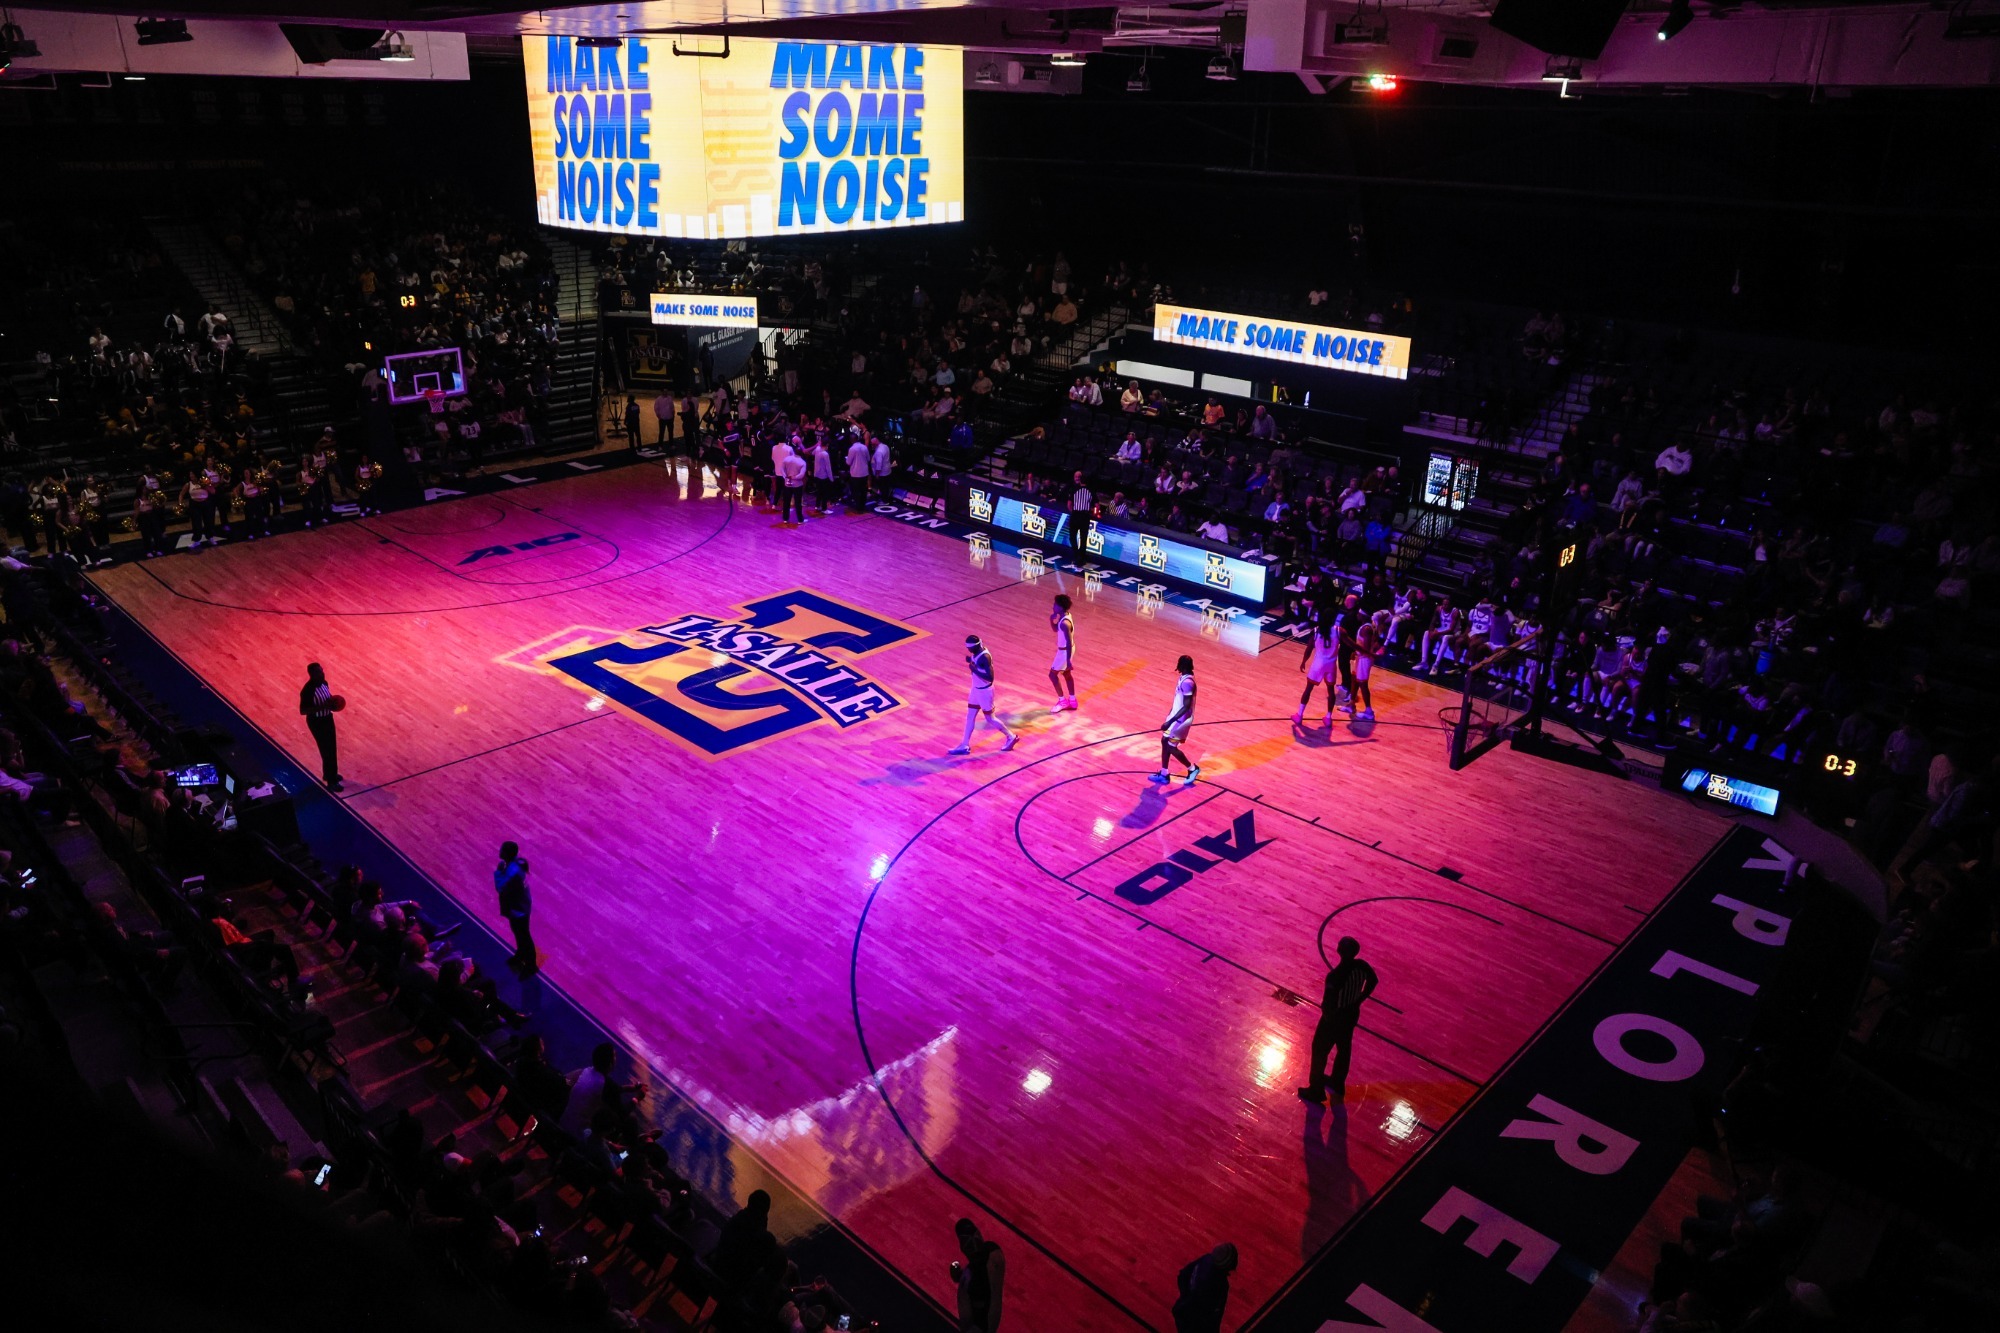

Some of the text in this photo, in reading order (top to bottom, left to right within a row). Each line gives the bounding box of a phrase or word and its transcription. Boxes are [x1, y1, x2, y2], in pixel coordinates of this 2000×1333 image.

[547, 36, 650, 94] MAKE
[769, 42, 925, 90] MAKE
[554, 93, 652, 159] SOME
[778, 91, 926, 159] SOME
[557, 160, 661, 228] NOISE
[777, 158, 930, 227] NOISE
[655, 302, 756, 318] MAKE SOME NOISE
[1176, 313, 1384, 366] MAKE SOME NOISE
[650, 615, 897, 724] LASALLE
